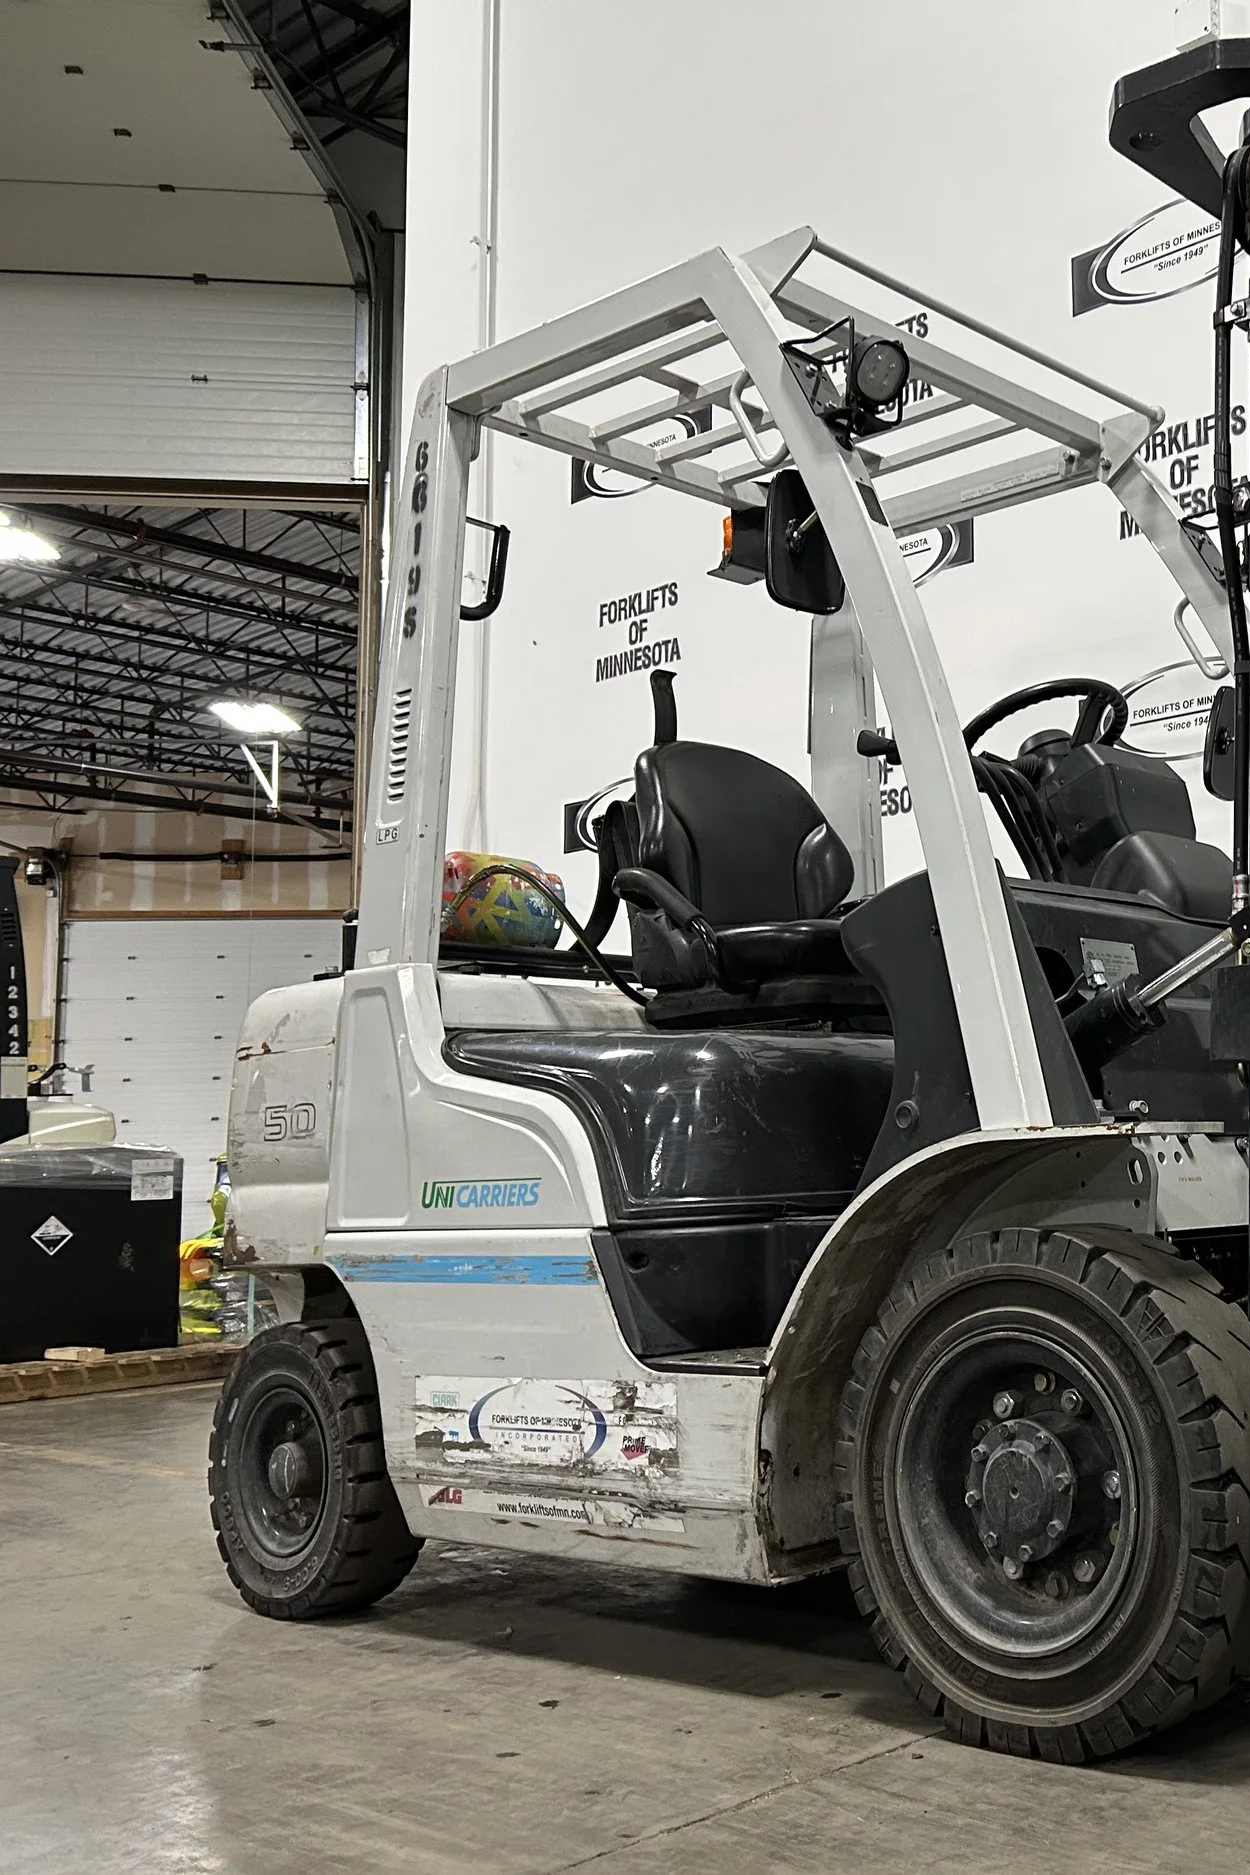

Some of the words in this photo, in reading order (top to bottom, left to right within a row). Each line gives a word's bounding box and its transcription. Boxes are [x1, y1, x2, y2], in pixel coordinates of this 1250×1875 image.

[1123, 240, 1171, 266] FORKLIFTS
[1172, 234, 1185, 247] OF
[1186, 221, 1221, 241] MINNES
[1169, 454, 1200, 490] OF
[599, 582, 678, 628] FORKLIFTS
[628, 618, 648, 645] OF
[595, 637, 682, 683] MINNESOTA
[1133, 704, 1180, 719] FORKLIFTS
[1182, 698, 1195, 710] OF
[378, 828, 398, 842] LPG
[264, 1103, 316, 1141] 50
[421, 1180, 541, 1209] UNICARRIERS
[432, 1393, 458, 1407] CLARK
[492, 1414, 528, 1425] FORKLIFTS
[495, 1431, 578, 1444] INCORPORATED
